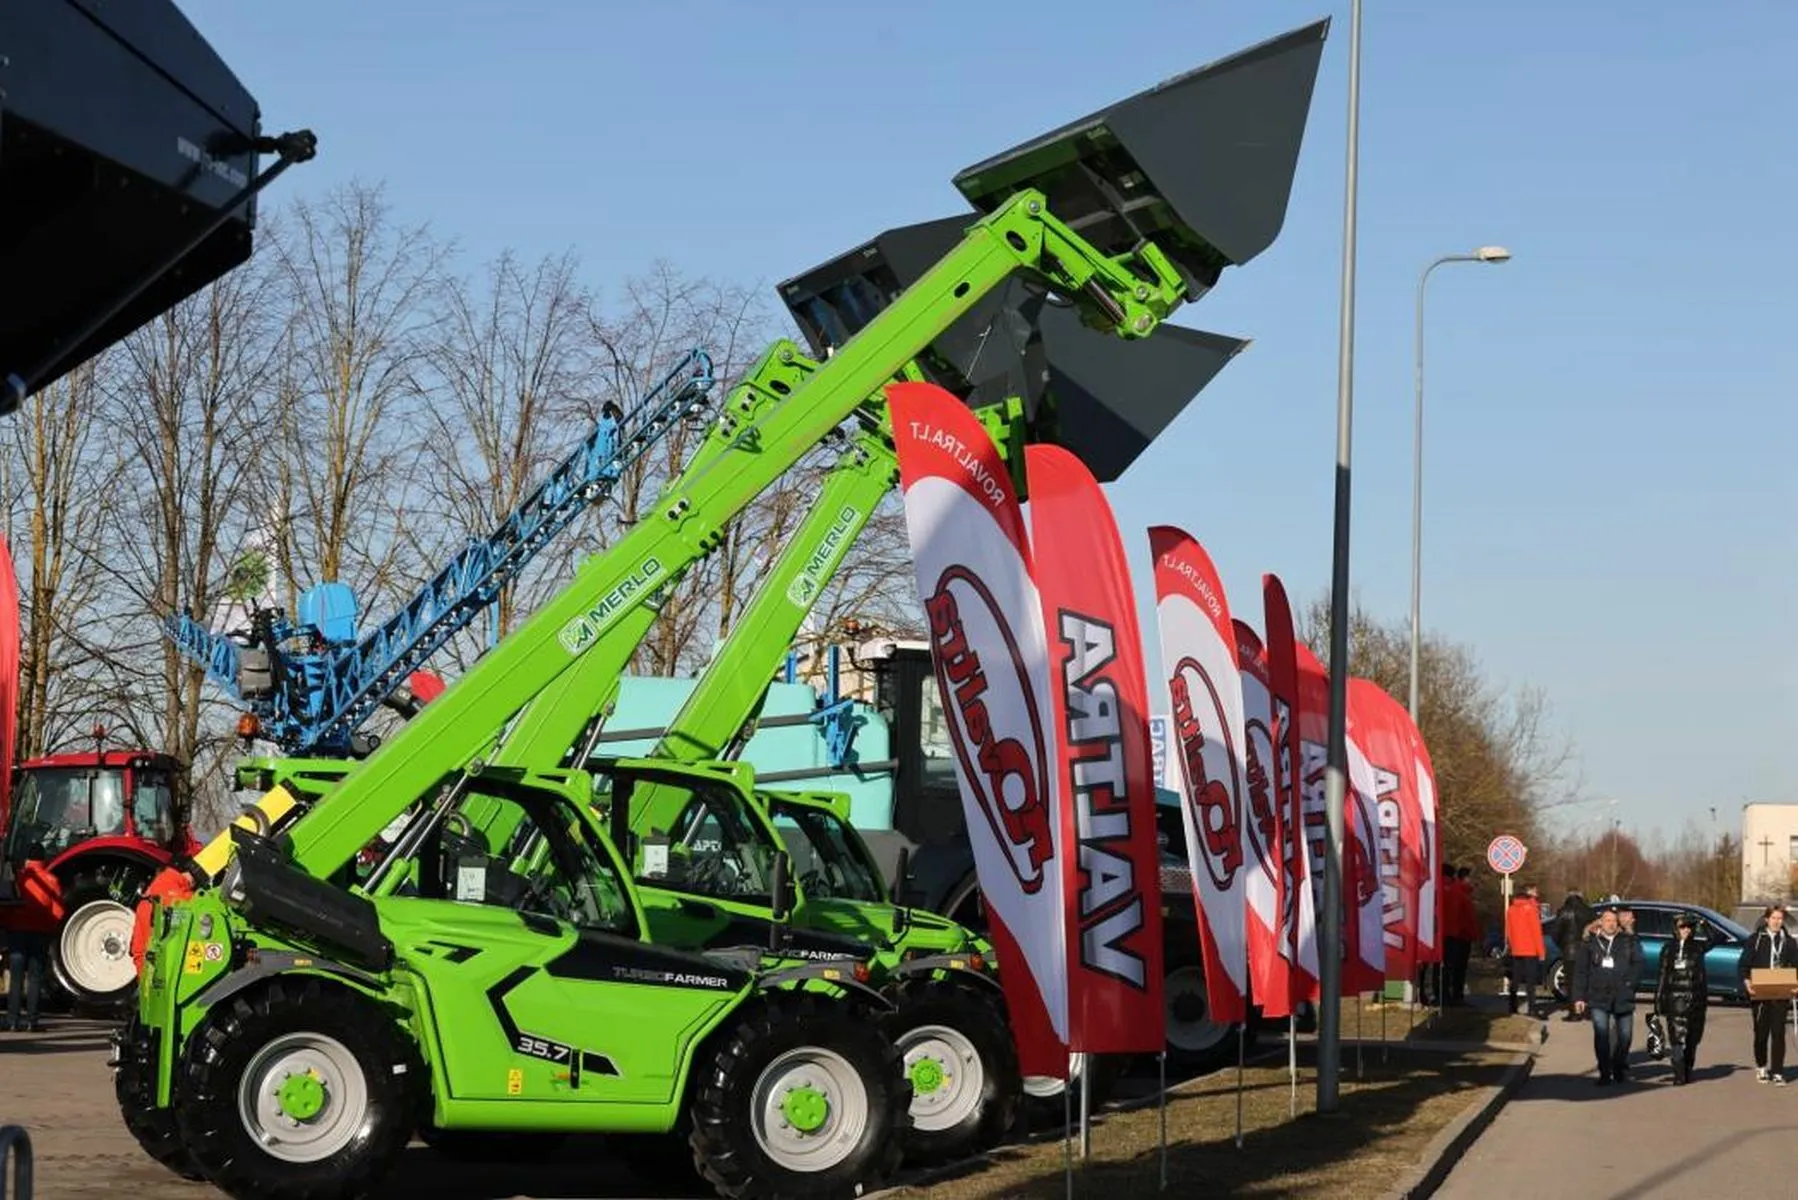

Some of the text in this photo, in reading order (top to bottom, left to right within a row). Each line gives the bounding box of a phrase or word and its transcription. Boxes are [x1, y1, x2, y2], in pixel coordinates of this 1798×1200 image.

[807, 506, 856, 577] MERLO
[588, 557, 662, 625] MERLO
[517, 1036, 570, 1060] 35.7
